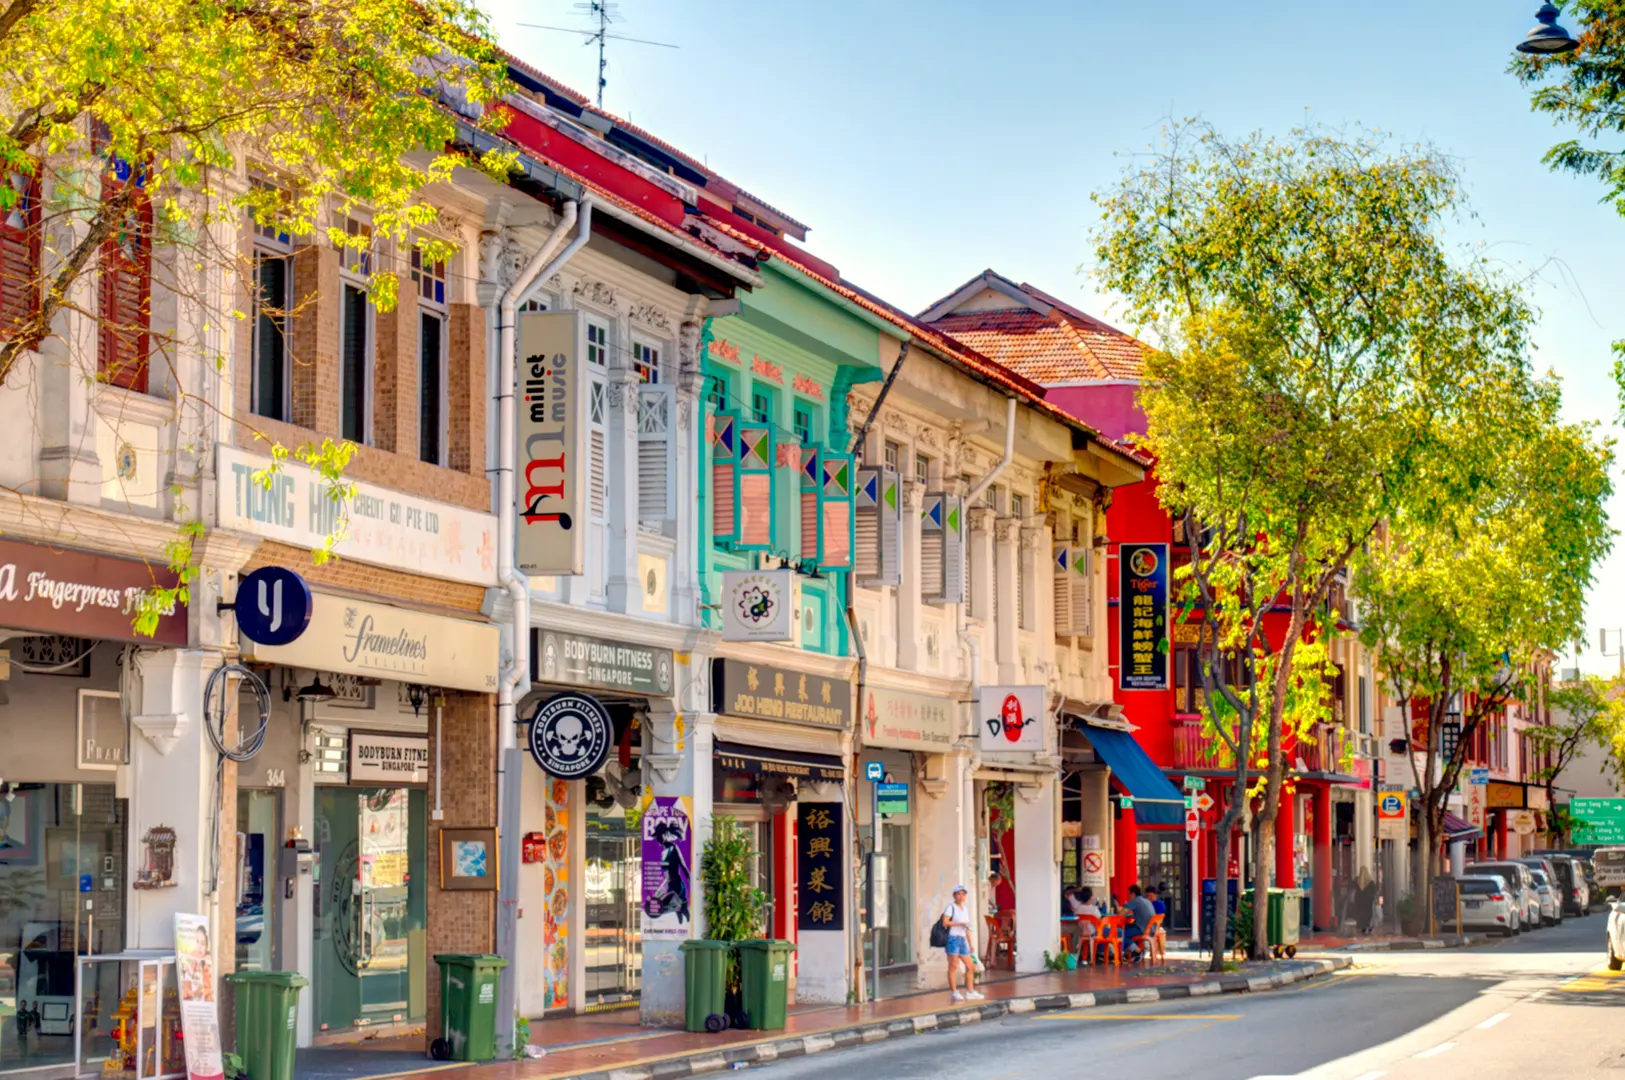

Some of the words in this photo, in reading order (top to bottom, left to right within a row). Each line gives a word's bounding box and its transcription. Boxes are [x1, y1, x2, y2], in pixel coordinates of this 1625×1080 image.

[525, 354, 545, 423] millet
[546, 353, 567, 422] music
[353, 493, 384, 520] CREDIT
[389, 500, 401, 525] CO
[406, 506, 422, 530] PTE
[425, 511, 439, 534] LTD
[24, 571, 121, 612] Fingerpress
[564, 639, 616, 665] BODYBURN
[617, 648, 653, 670] FITNESS
[587, 666, 632, 685] SINGAPORE
[537, 701, 573, 735] BODYBURN
[576, 702, 602, 734] FITNESS
[734, 693, 755, 713] JOO
[784, 701, 842, 724] RESTAURANT
[358, 745, 403, 760] BODYBURN
[381, 761, 415, 772] SINGAPORE
[546, 757, 591, 772] SINGAPORE
[266, 768, 285, 786] 364
[805, 808, 835, 924] 裕興菜館
